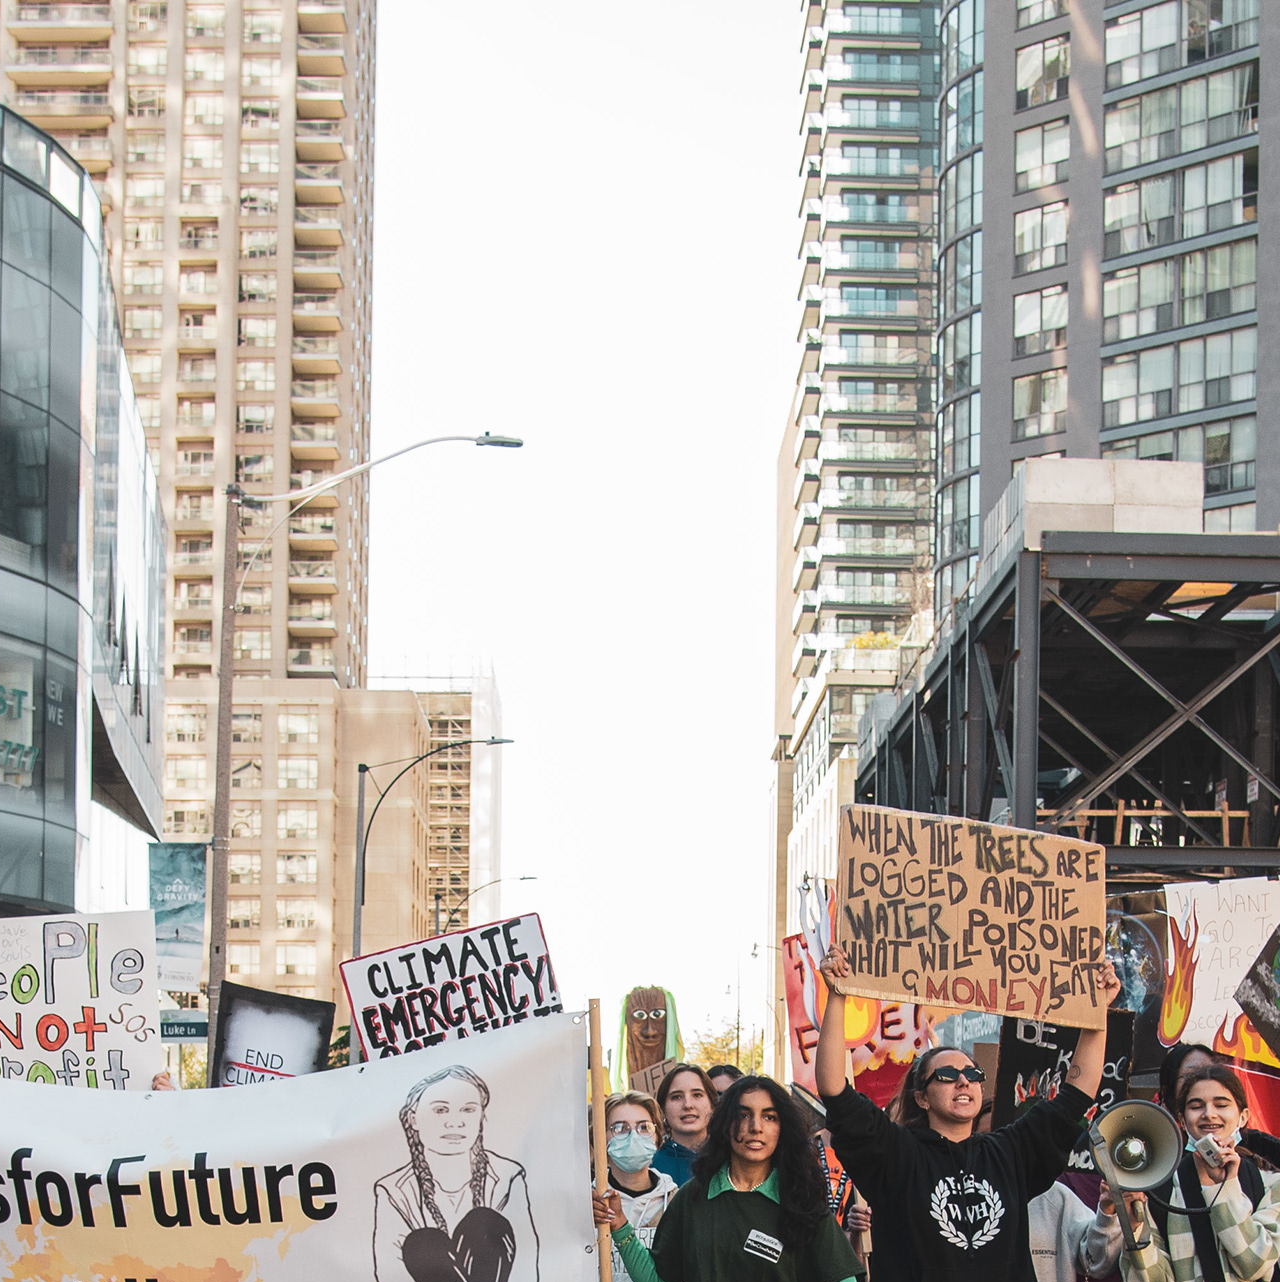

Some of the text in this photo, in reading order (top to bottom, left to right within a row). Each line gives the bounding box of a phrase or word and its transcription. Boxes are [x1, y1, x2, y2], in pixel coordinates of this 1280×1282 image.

[847, 808, 1101, 883] WHEN THE TREES ARE
[157, 893, 199, 901] GRAVITY
[165, 884, 190, 894] DEFY
[847, 857, 1080, 921] LOGGED AND THE
[1211, 882, 1271, 915] WANT
[1, 937, 23, 948] our
[844, 898, 1104, 963] WATER POISONED
[1202, 919, 1235, 944] GO
[367, 918, 529, 999] CLIMATE
[841, 937, 911, 978] WHAT
[918, 928, 982, 973] WILL
[1050, 959, 1104, 1007] EAT
[1198, 943, 1261, 973] ARS
[163, 973, 195, 983] TORONTO
[361, 952, 558, 1050] EMERGENCY!
[163, 1023, 197, 1036] Luke Ln
[1016, 1017, 1058, 1050] BE
[245, 1048, 284, 1069] END
